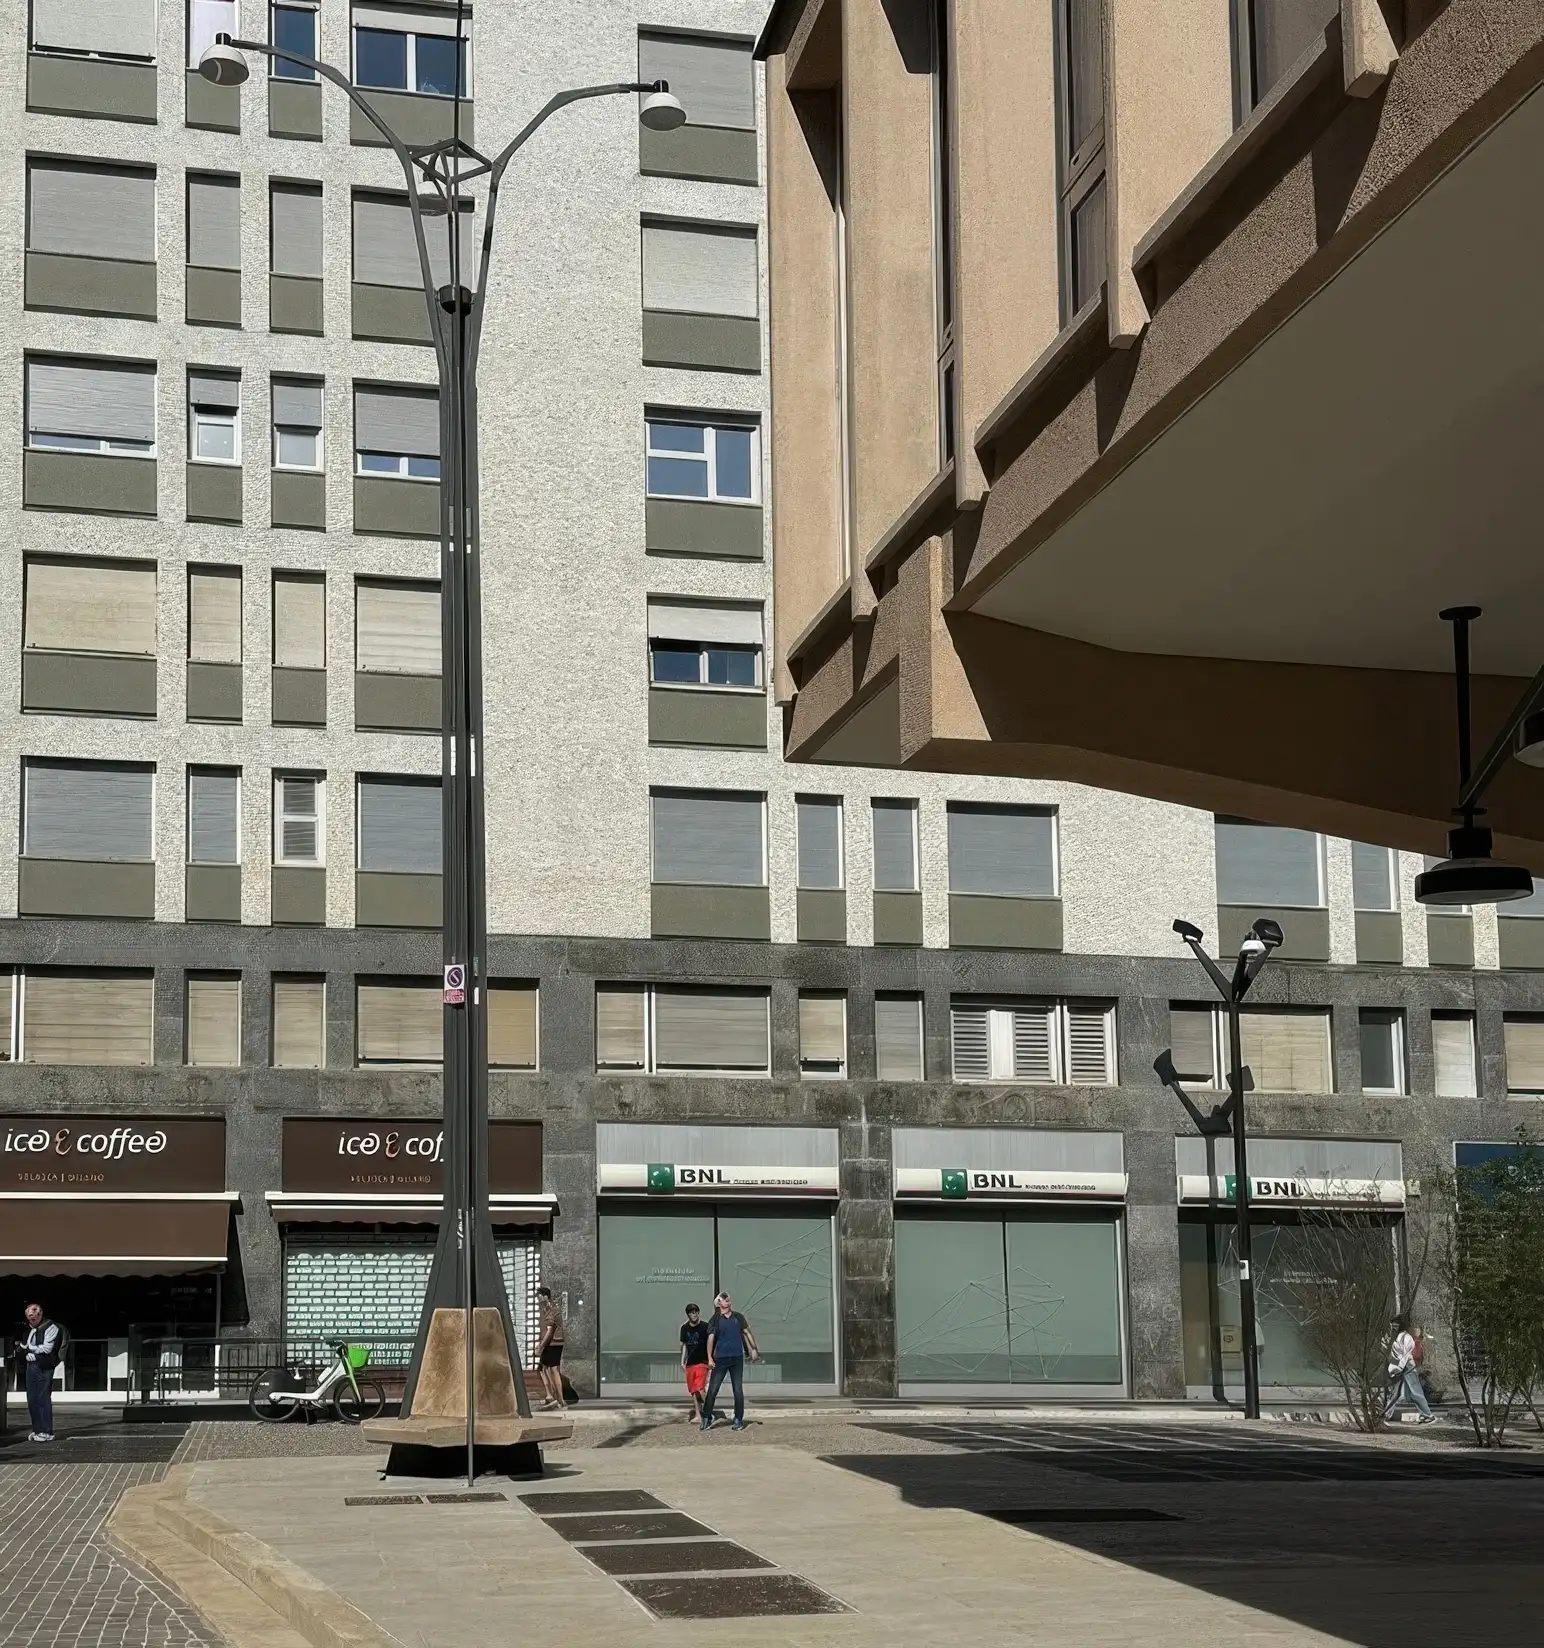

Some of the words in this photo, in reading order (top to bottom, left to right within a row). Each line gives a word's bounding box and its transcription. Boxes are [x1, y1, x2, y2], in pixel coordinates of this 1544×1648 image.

[4, 1128, 50, 1152] ice
[77, 1128, 167, 1160] coffee
[338, 1131, 380, 1155] ice
[405, 1131, 444, 1162] cof
[680, 1168, 731, 1184] BNL
[973, 1173, 1023, 1189] BNL
[1256, 1181, 1304, 1197] BNL
